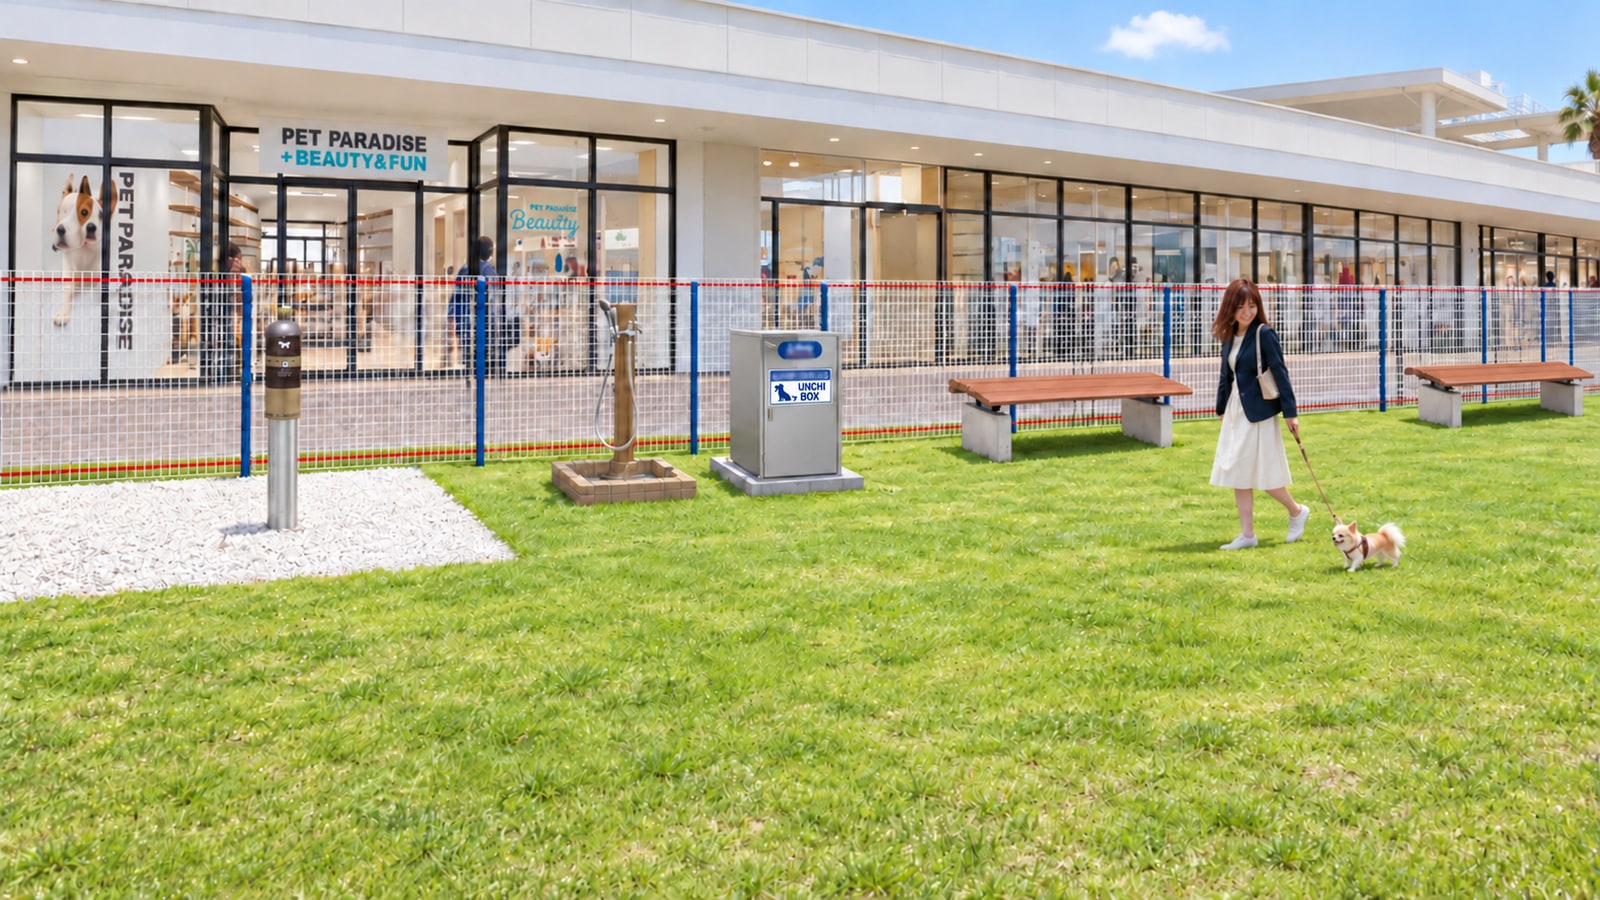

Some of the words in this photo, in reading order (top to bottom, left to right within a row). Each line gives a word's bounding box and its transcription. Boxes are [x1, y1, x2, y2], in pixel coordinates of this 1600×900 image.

[281, 127, 321, 146] PET
[328, 130, 427, 152] PARADISE
[118, 172, 134, 219] PET
[529, 203, 543, 211] PET
[798, 382, 826, 391] UNCHI
[800, 392, 820, 401] BOX
